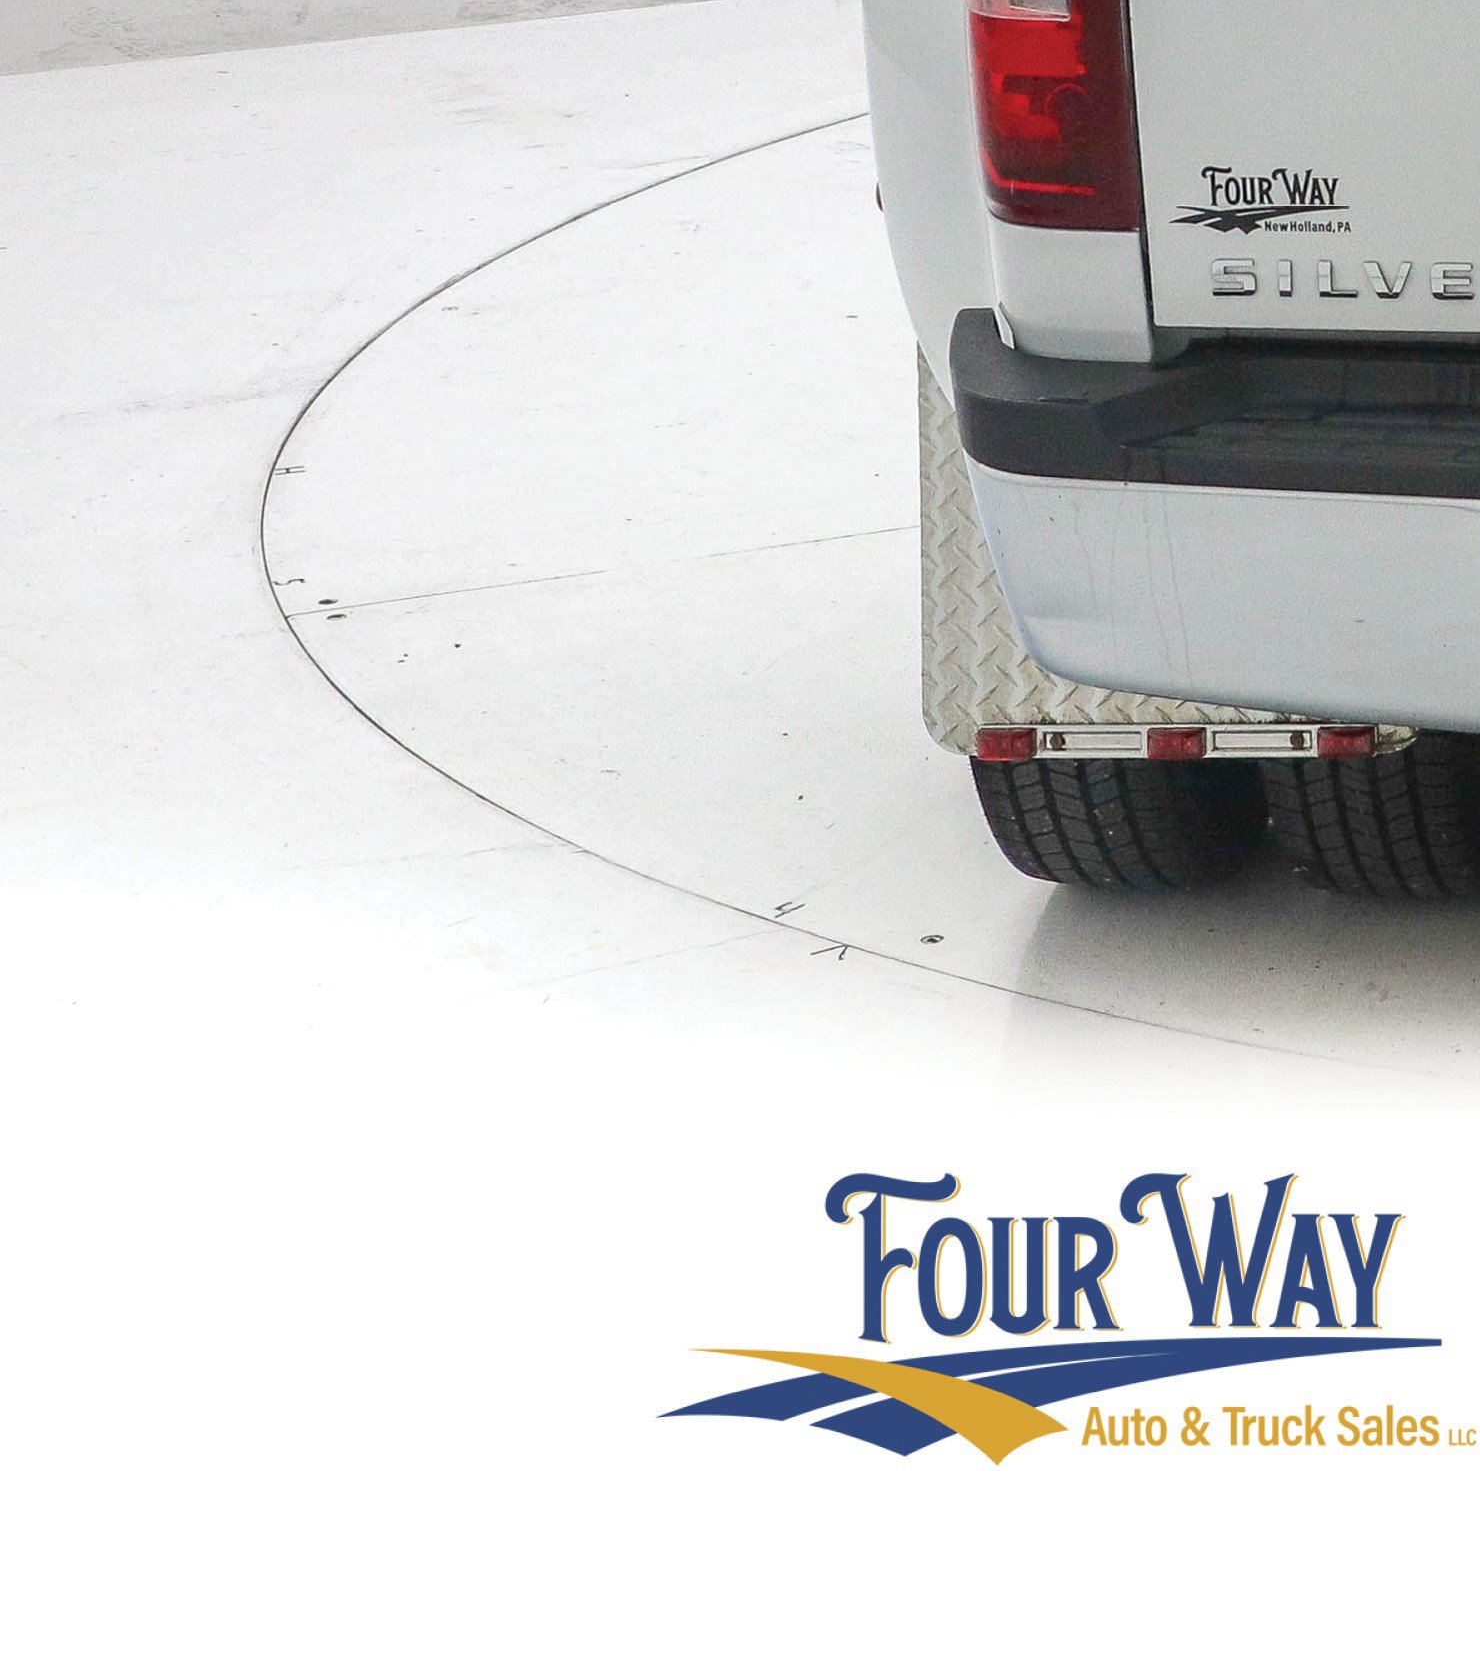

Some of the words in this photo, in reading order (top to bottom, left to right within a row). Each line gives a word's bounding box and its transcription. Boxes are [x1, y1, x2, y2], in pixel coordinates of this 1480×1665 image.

[1201, 166, 1274, 206] FOUR
[1271, 168, 1339, 205] WAY
[1264, 221, 1290, 232] New
[1290, 221, 1336, 234] Holland,
[1338, 222, 1352, 232] PA
